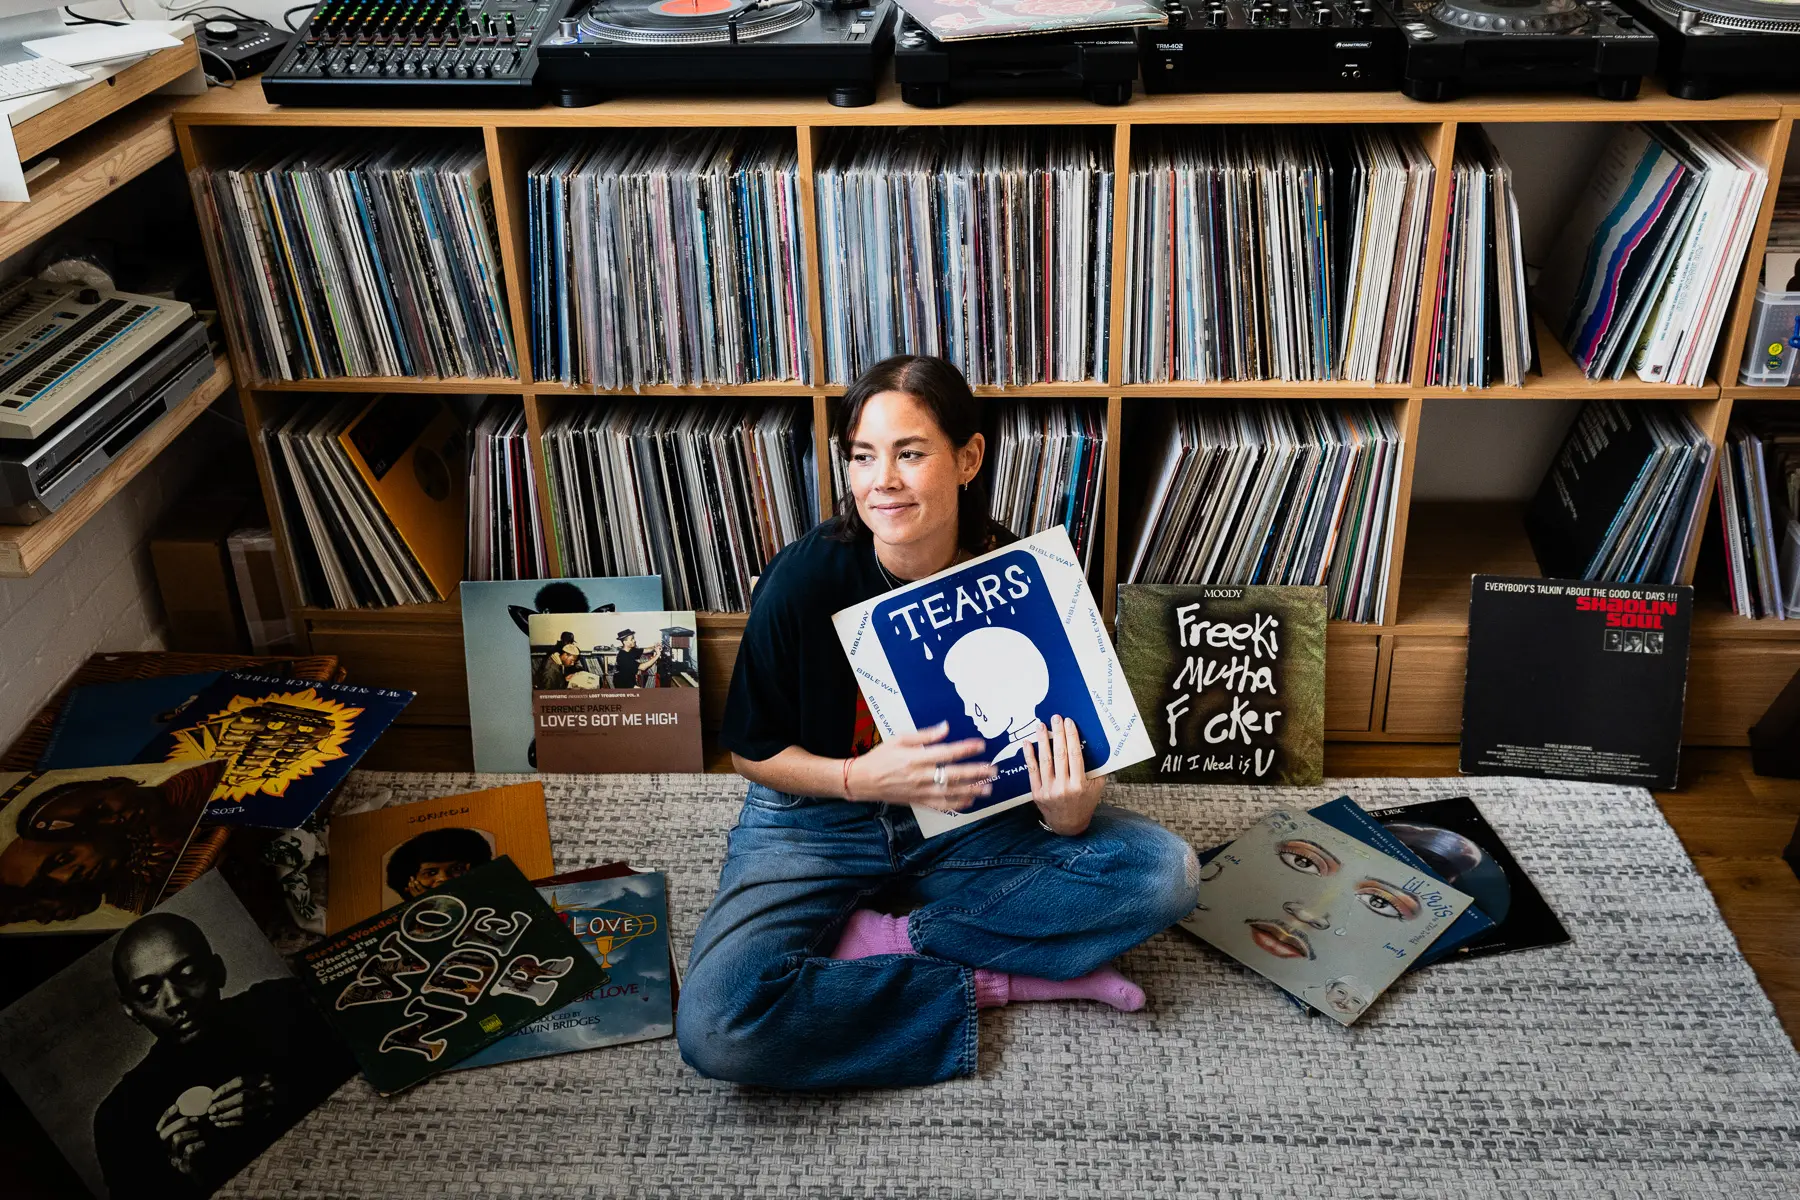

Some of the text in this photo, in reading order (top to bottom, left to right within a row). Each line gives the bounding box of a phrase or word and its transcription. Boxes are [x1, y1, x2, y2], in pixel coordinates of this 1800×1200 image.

[1204, 589, 1242, 598] MOODY
[1484, 582, 1678, 602] EVERYBODY'S TALKIN' ABOUT THE GOOD OL' DAYS !!!
[888, 564, 1031, 642] TEARS
[1605, 612, 1664, 630] SOUL
[285, 678, 324, 689] EACH
[1173, 656, 1277, 695] Mutha
[330, 684, 370, 694] NEED
[376, 688, 400, 699] WE
[540, 704, 622, 714] TERRENCE PARKER
[540, 712, 678, 728] LOVE'S GOT ME HIGH
[1161, 748, 1275, 777] All I Need is U
[1383, 808, 1406, 816] DISC
[1366, 824, 1389, 844] MICHAEL
[573, 917, 634, 936] LOVE
[304, 914, 400, 961] Stevie Wonder
[311, 936, 378, 970] Where I'm
[316, 950, 368, 978] Coming
[318, 964, 359, 986] From
[600, 984, 640, 999] LOVE
[552, 1015, 602, 1029] BRIDGES
[572, 1010, 582, 1018] BY
